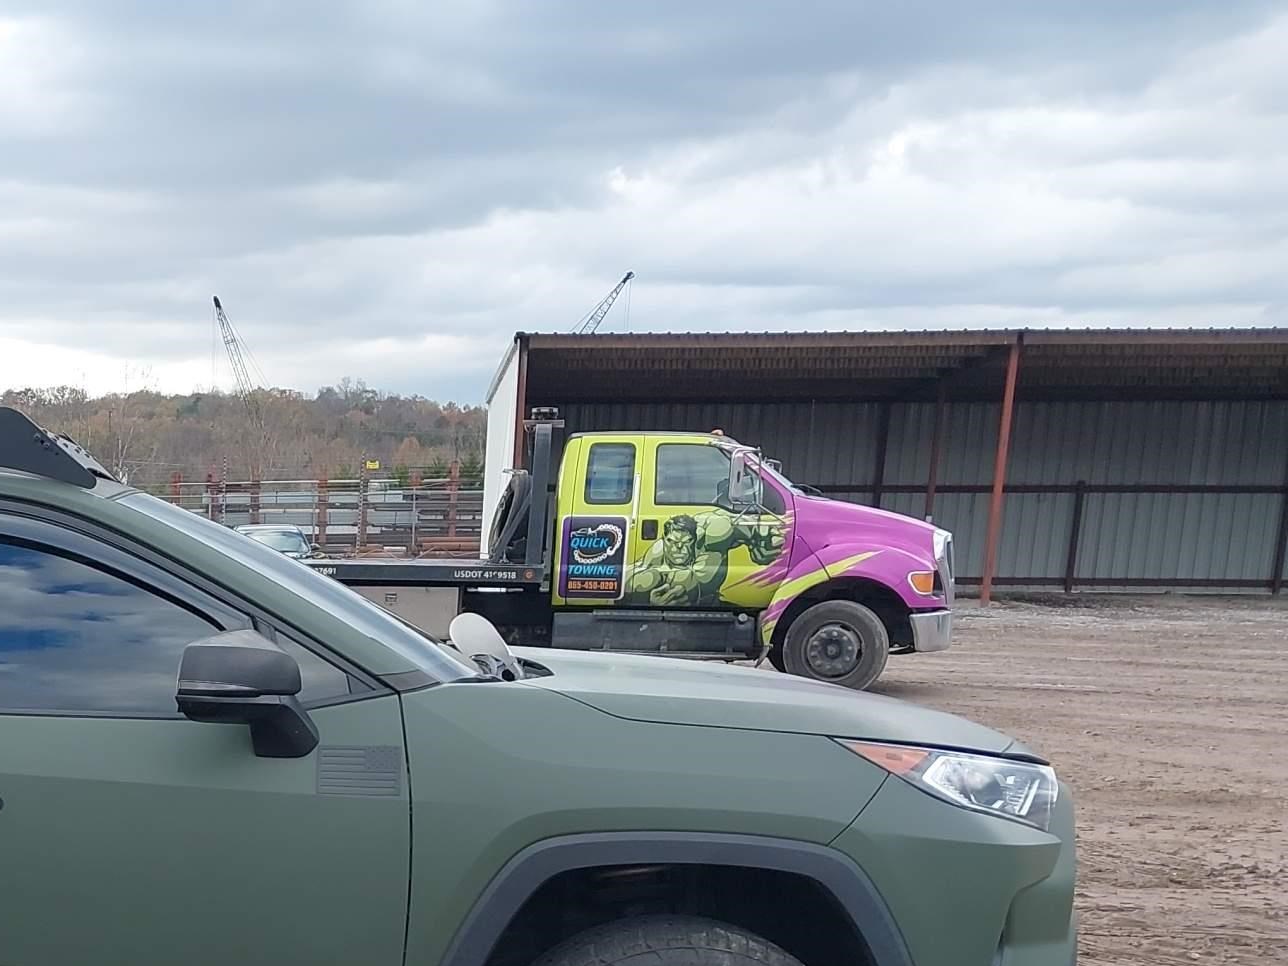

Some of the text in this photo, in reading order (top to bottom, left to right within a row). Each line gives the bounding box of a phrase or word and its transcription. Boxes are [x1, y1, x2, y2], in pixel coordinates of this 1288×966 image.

[571, 537, 608, 549] QUICK
[454, 570, 482, 578] USDOT
[569, 565, 615, 575] TOWING
